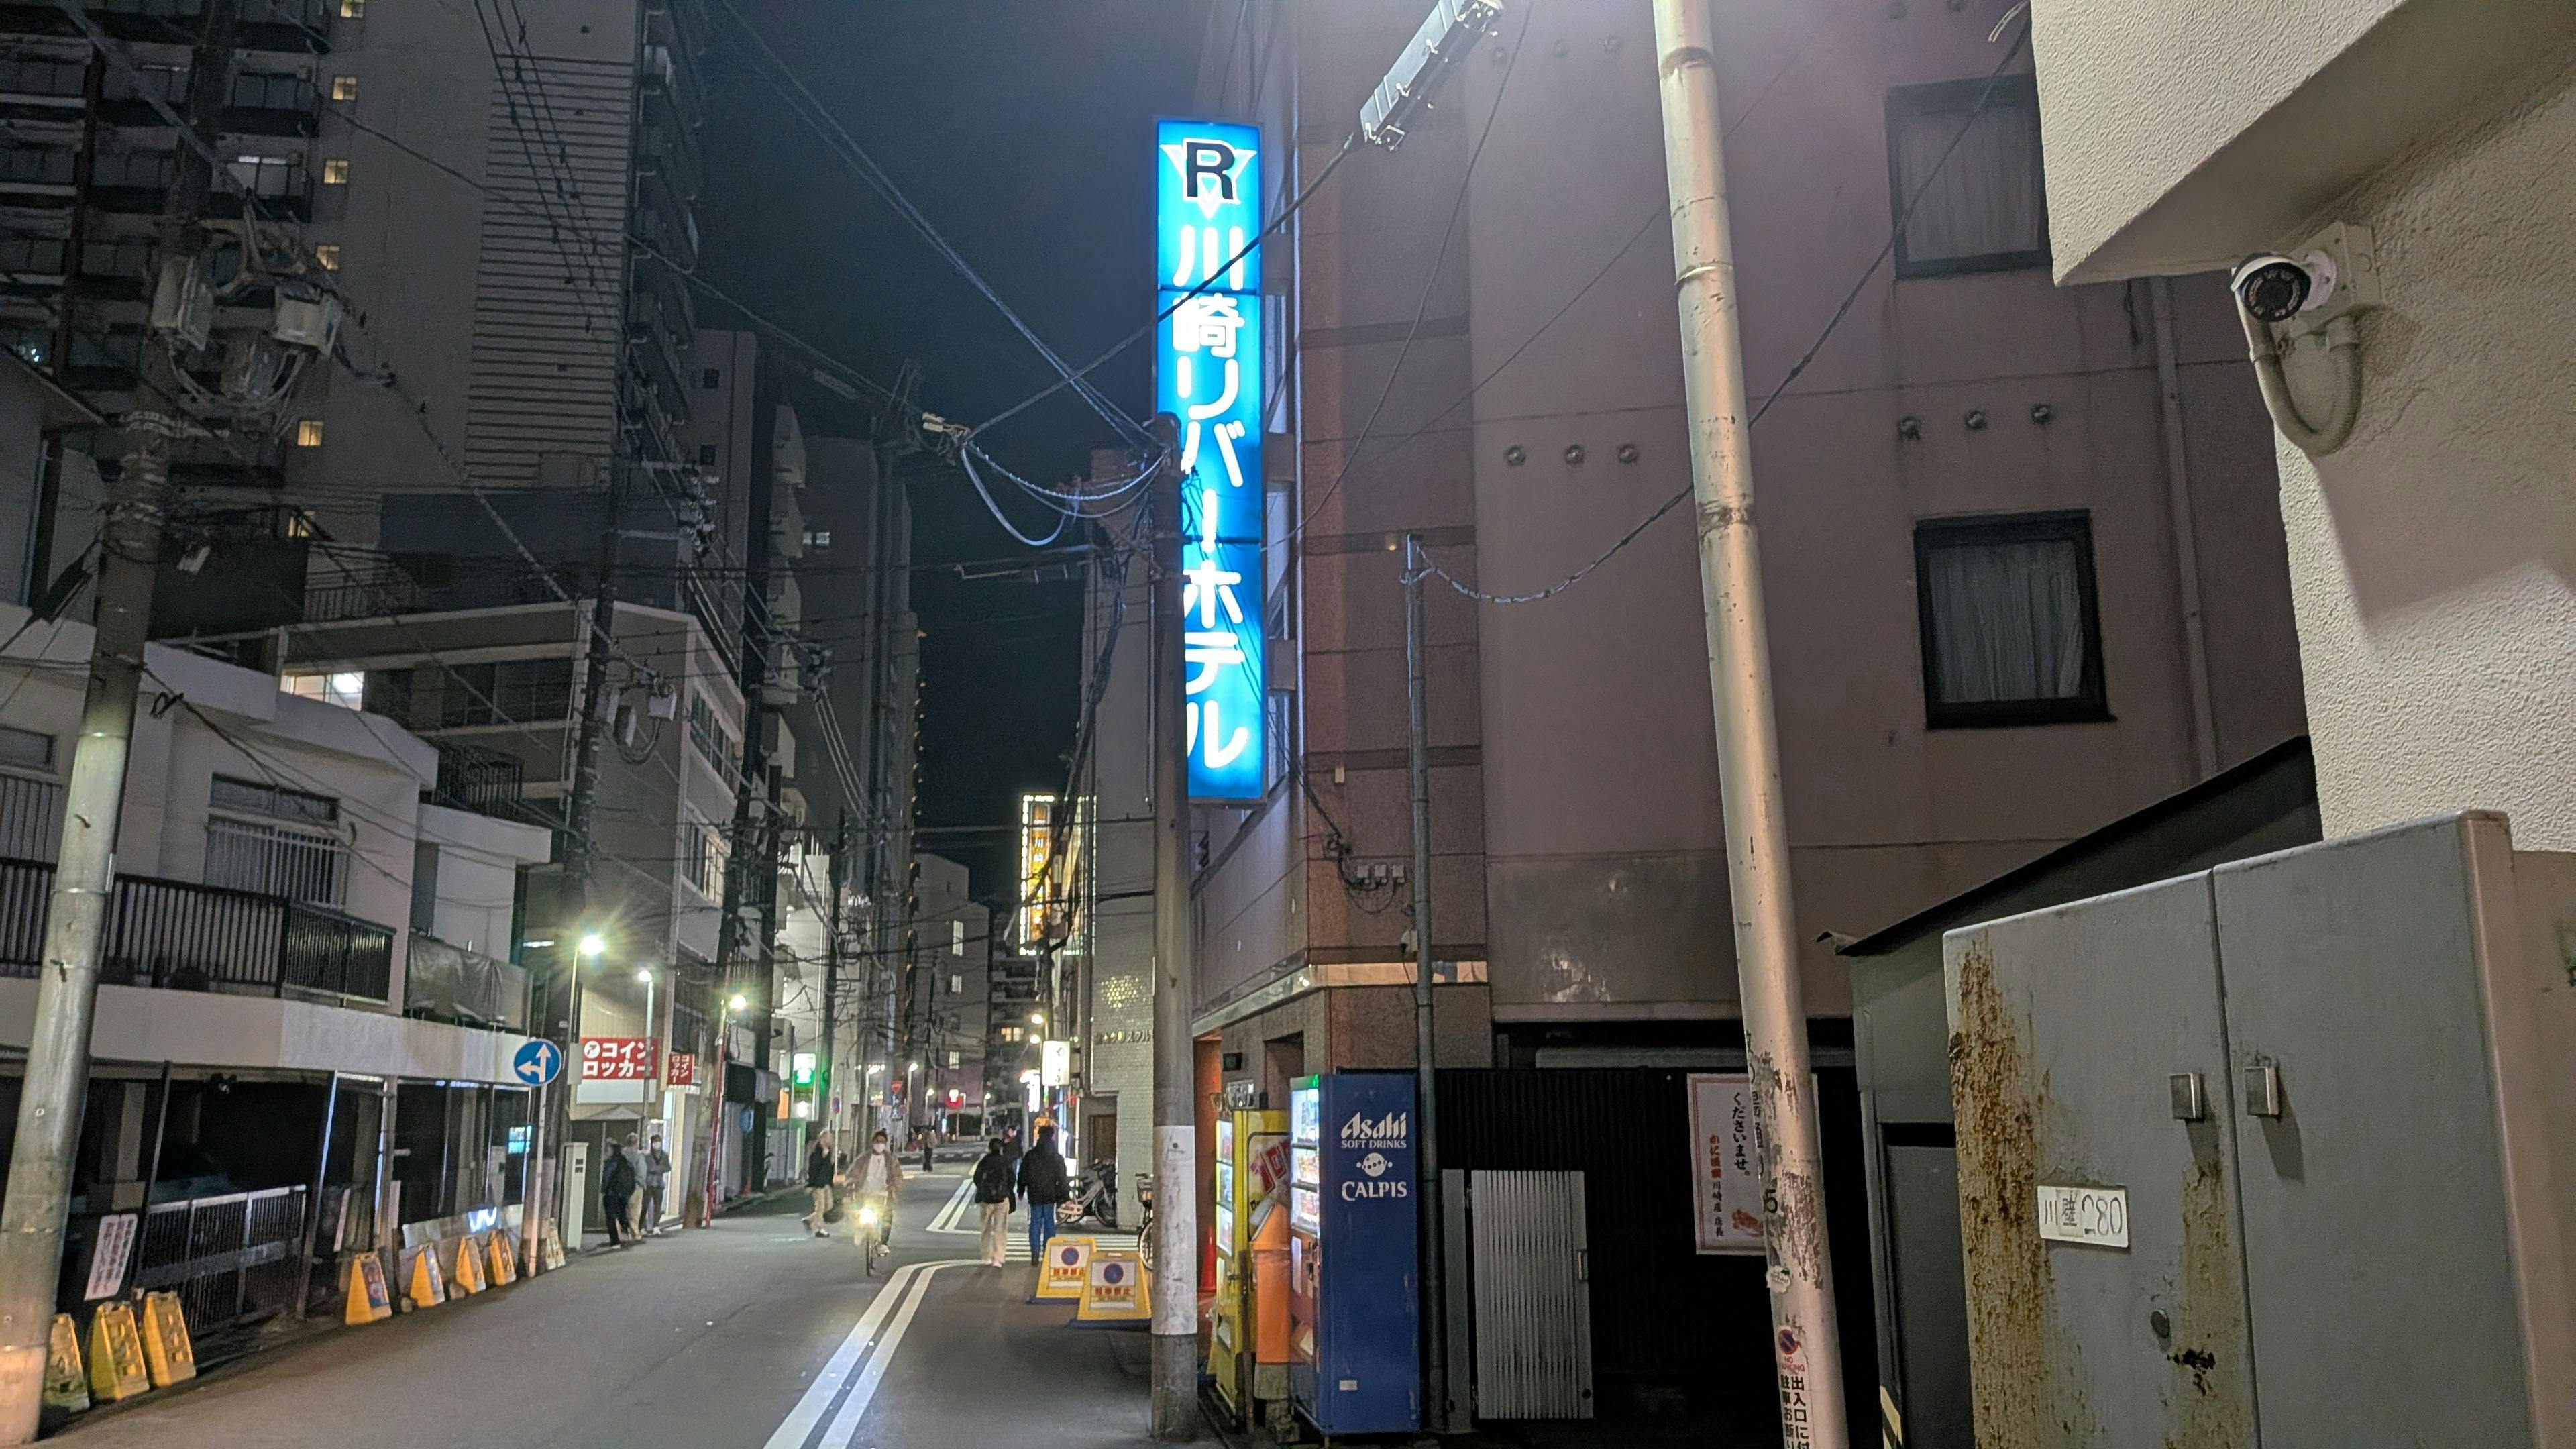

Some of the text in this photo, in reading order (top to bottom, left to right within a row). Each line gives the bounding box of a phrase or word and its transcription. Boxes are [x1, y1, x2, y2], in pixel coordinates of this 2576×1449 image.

[1183, 138, 1240, 204] R
[1173, 225, 1249, 769] 川崎リバーホテル
[602, 1041, 653, 1059] コイン
[582, 1060, 653, 1077] ロッカー
[670, 1055, 680, 1083] ロッカー
[680, 1055, 690, 1077] コイン
[1341, 1111, 1407, 1139] Asahi
[1341, 1140, 1407, 1149] SOFT DRINKS
[1341, 1181, 1407, 1201] CALPIS
[1781, 1363, 1805, 1373] ARKING
